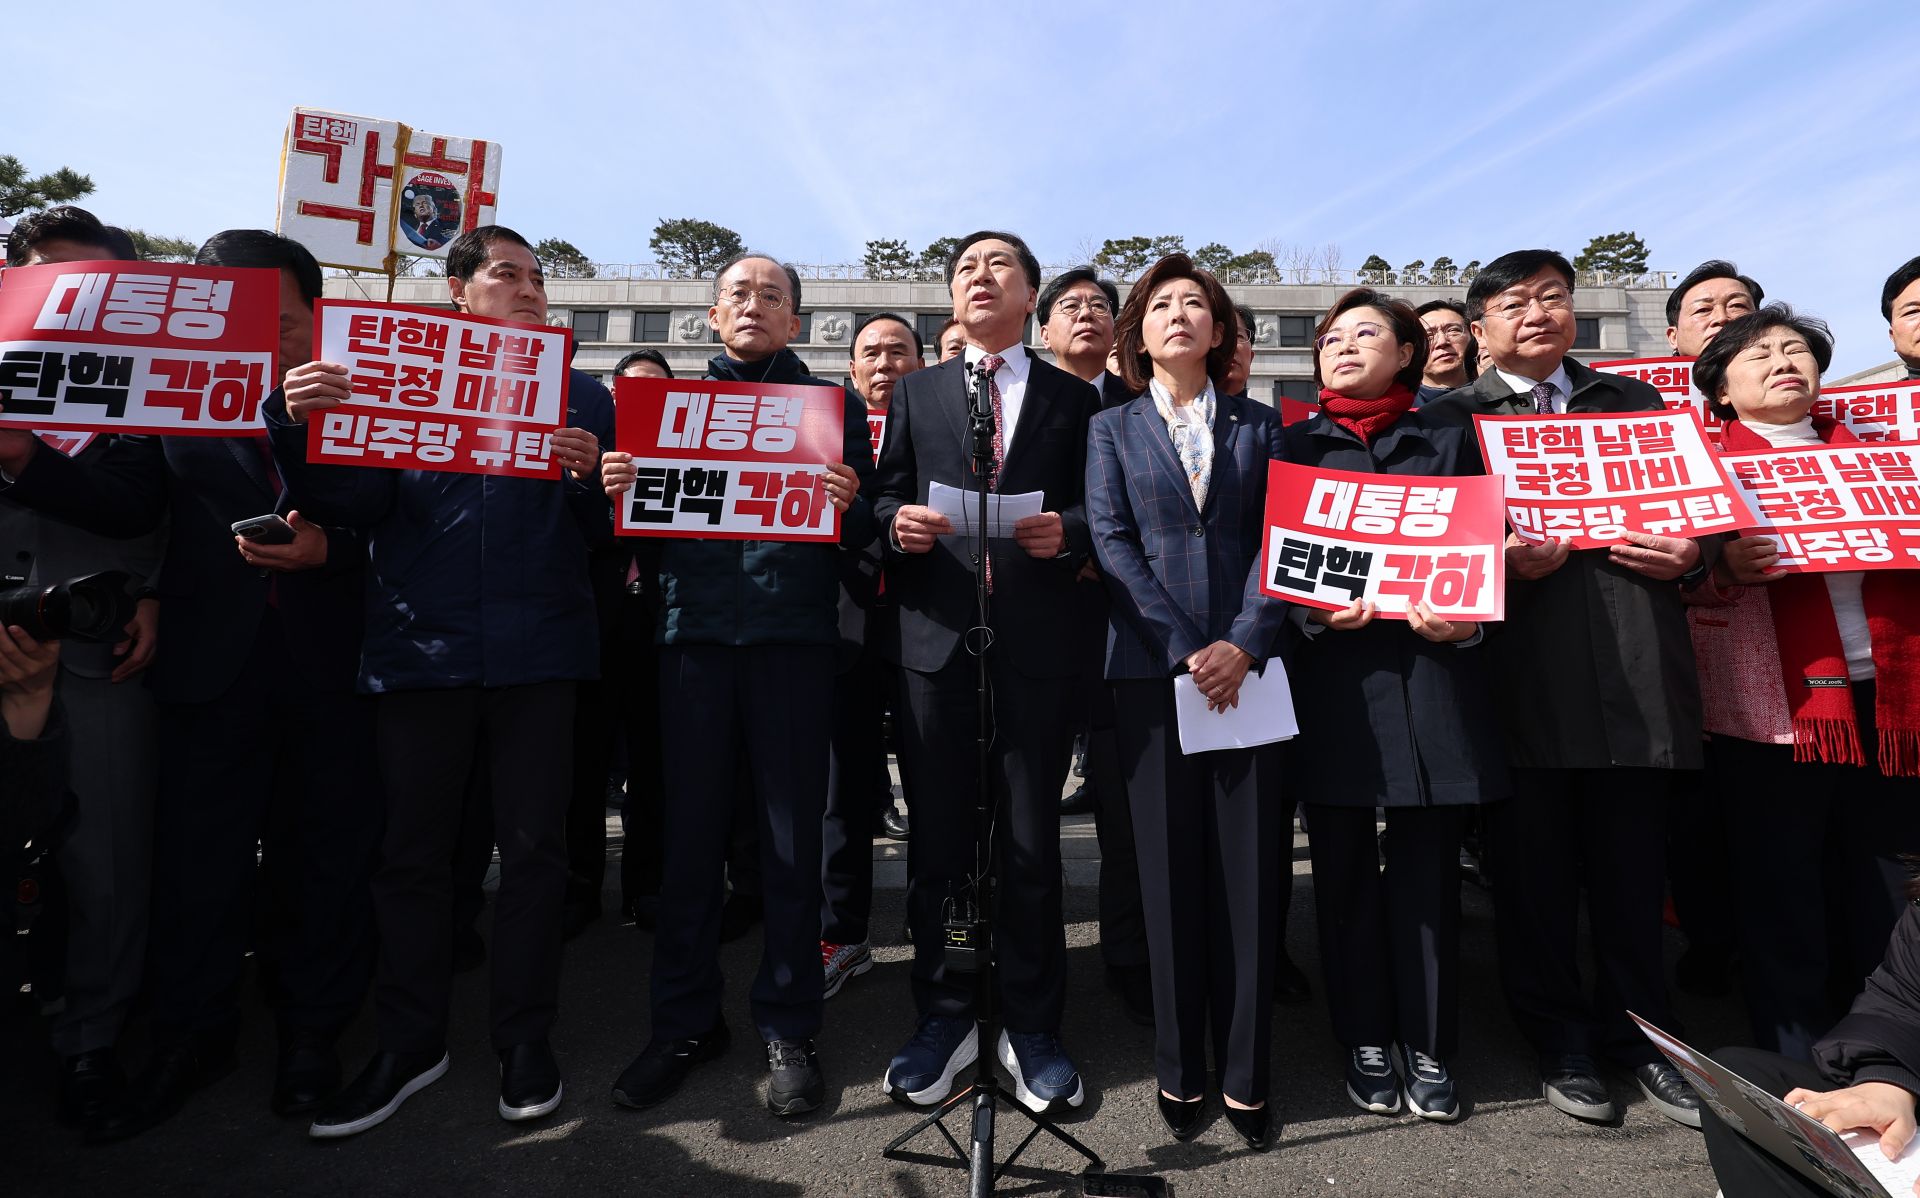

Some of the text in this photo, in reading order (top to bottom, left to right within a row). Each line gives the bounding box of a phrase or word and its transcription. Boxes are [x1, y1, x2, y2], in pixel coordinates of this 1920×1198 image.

[303, 116, 357, 145] 탄핵
[417, 174, 432, 183] SAGE
[33, 272, 234, 339] 대통령
[347, 314, 544, 375] 탄핵 남발
[0, 351, 264, 422] 탄핵 각하
[351, 359, 539, 417] 국정 마비
[321, 413, 554, 471] 민주당 규탄
[657, 391, 803, 453] 대통령
[1502, 422, 1676, 458] 탄핵 남발
[630, 467, 828, 528] 탄핵 각하
[1516, 455, 1691, 495] 국정 마비
[1732, 452, 1918, 490] 탄핵 남발
[1302, 478, 1458, 537] 대통령
[1508, 493, 1735, 543] 민주당 규탄
[1756, 489, 1847, 521] 국정
[1274, 537, 1485, 607] 탄핵 각하
